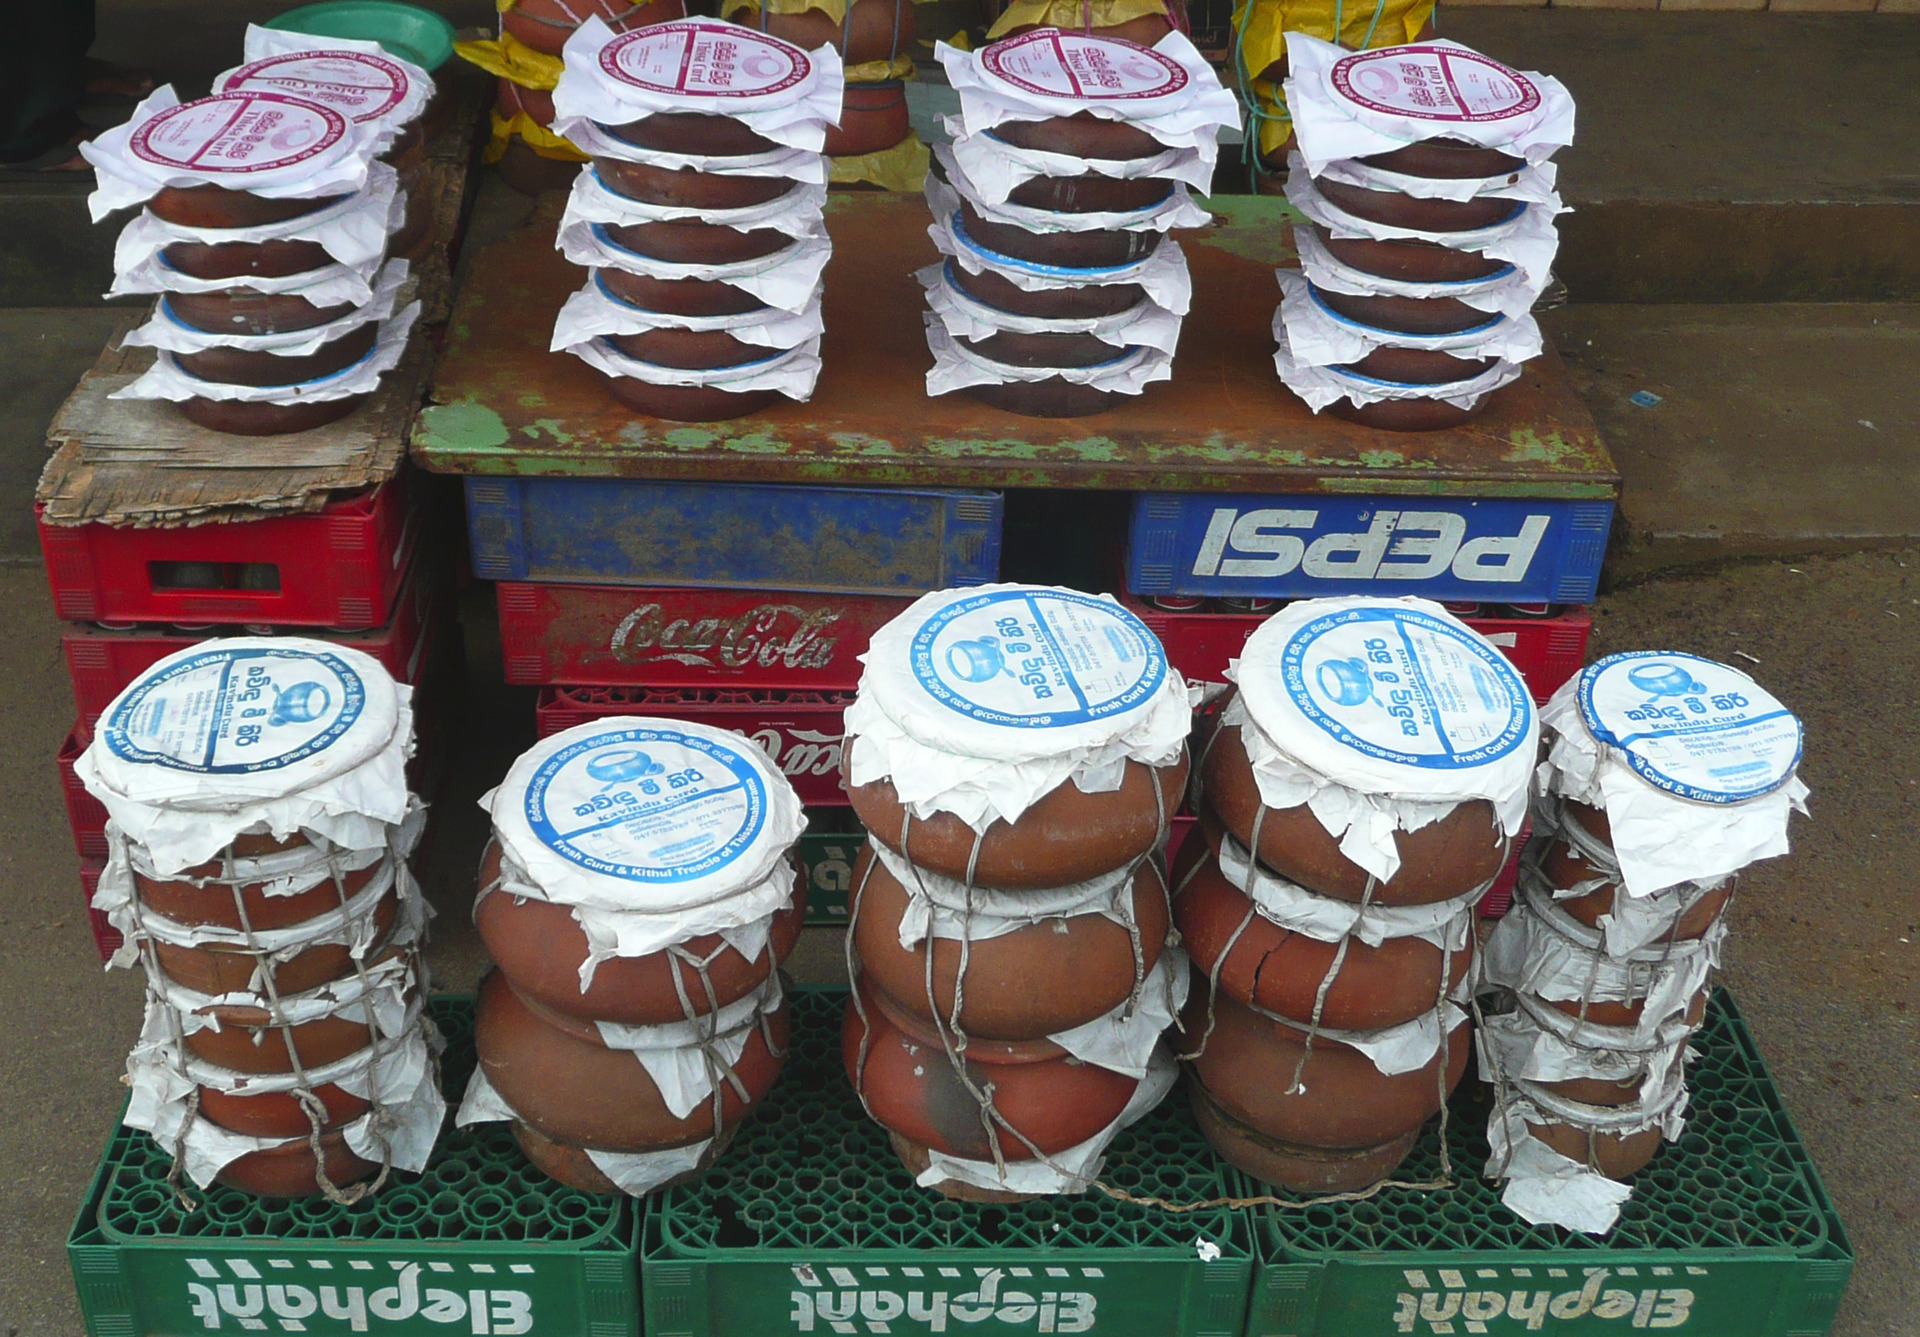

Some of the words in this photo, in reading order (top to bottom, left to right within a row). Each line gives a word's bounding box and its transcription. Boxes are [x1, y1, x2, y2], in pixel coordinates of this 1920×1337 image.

[690, 64, 707, 83] Curd
[1424, 65, 1442, 84] Curd
[1192, 508, 1551, 582] PEPSI
[611, 603, 846, 668] Coca-Cola
[994, 617, 1025, 638] කිරි
[1028, 622, 1045, 643] Curd
[1006, 642, 1032, 654] මී
[1364, 638, 1394, 664] කිරි
[194, 653, 231, 668] Fresh
[1041, 644, 1066, 687] Kavindu
[1145, 654, 1161, 681] Kithul
[1396, 648, 1412, 676] Curd
[1492, 662, 1506, 672] of
[163, 664, 192, 680] Curd
[1374, 670, 1400, 684] මී
[1140, 679, 1153, 688] &
[224, 675, 240, 718] Kavindu
[1121, 686, 1147, 704] Curd
[1408, 677, 1432, 726] Kavindu
[241, 708, 267, 718] මී
[1087, 700, 1123, 716] Fresh
[1624, 703, 1688, 721] කවිඳු
[1684, 696, 1707, 714] මී
[1711, 692, 1750, 712] කිරි
[219, 718, 232, 739] Curd
[1508, 706, 1524, 733] Kithul
[1650, 717, 1710, 730] Kavindu
[1712, 712, 1748, 726] Curd
[235, 724, 262, 747] කිරි
[1486, 737, 1510, 754] Curd
[1504, 731, 1516, 740] &
[1452, 750, 1487, 764] Fresh
[573, 790, 639, 817] කවිඳු
[638, 778, 661, 796] මී
[667, 768, 704, 790] කිරි
[1644, 768, 1673, 790] Curd
[1674, 785, 1686, 796] &
[1689, 787, 1727, 803] Kithul
[598, 798, 661, 822] Kavindu
[664, 787, 700, 802] Curd
[552, 839, 582, 861] Fresh
[584, 857, 614, 872] Curd
[616, 864, 628, 876] &
[631, 867, 673, 878] Kithul
[674, 856, 722, 876] Treacle
[722, 846, 734, 858] of
[730, 777, 760, 848] Thissamaharama
[187, 1260, 534, 1335] Elephant
[790, 1268, 1098, 1333] Elephant
[1393, 1268, 1694, 1333] Elephant
